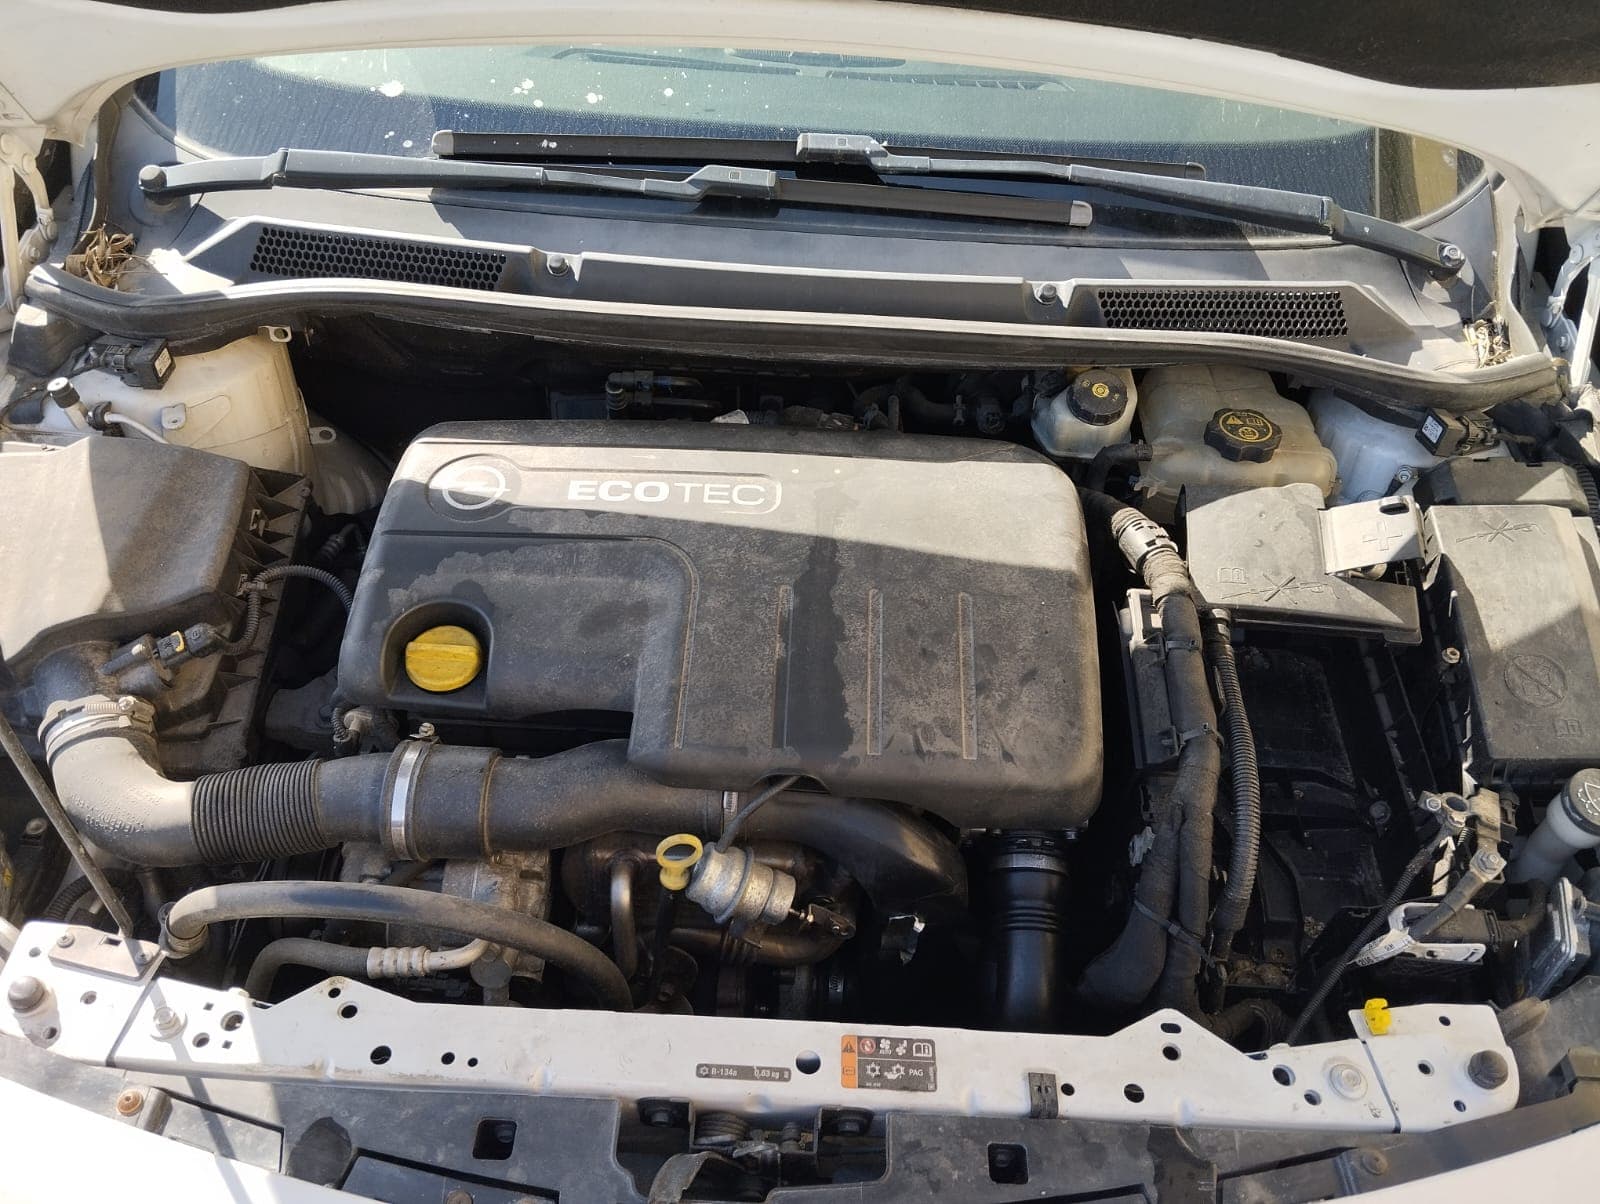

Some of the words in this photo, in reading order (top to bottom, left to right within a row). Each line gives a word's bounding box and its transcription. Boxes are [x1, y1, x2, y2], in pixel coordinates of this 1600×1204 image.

[567, 480, 767, 507] ECOTEC
[711, 1066, 738, 1077] R-134a
[909, 1068, 924, 1077] PAG
